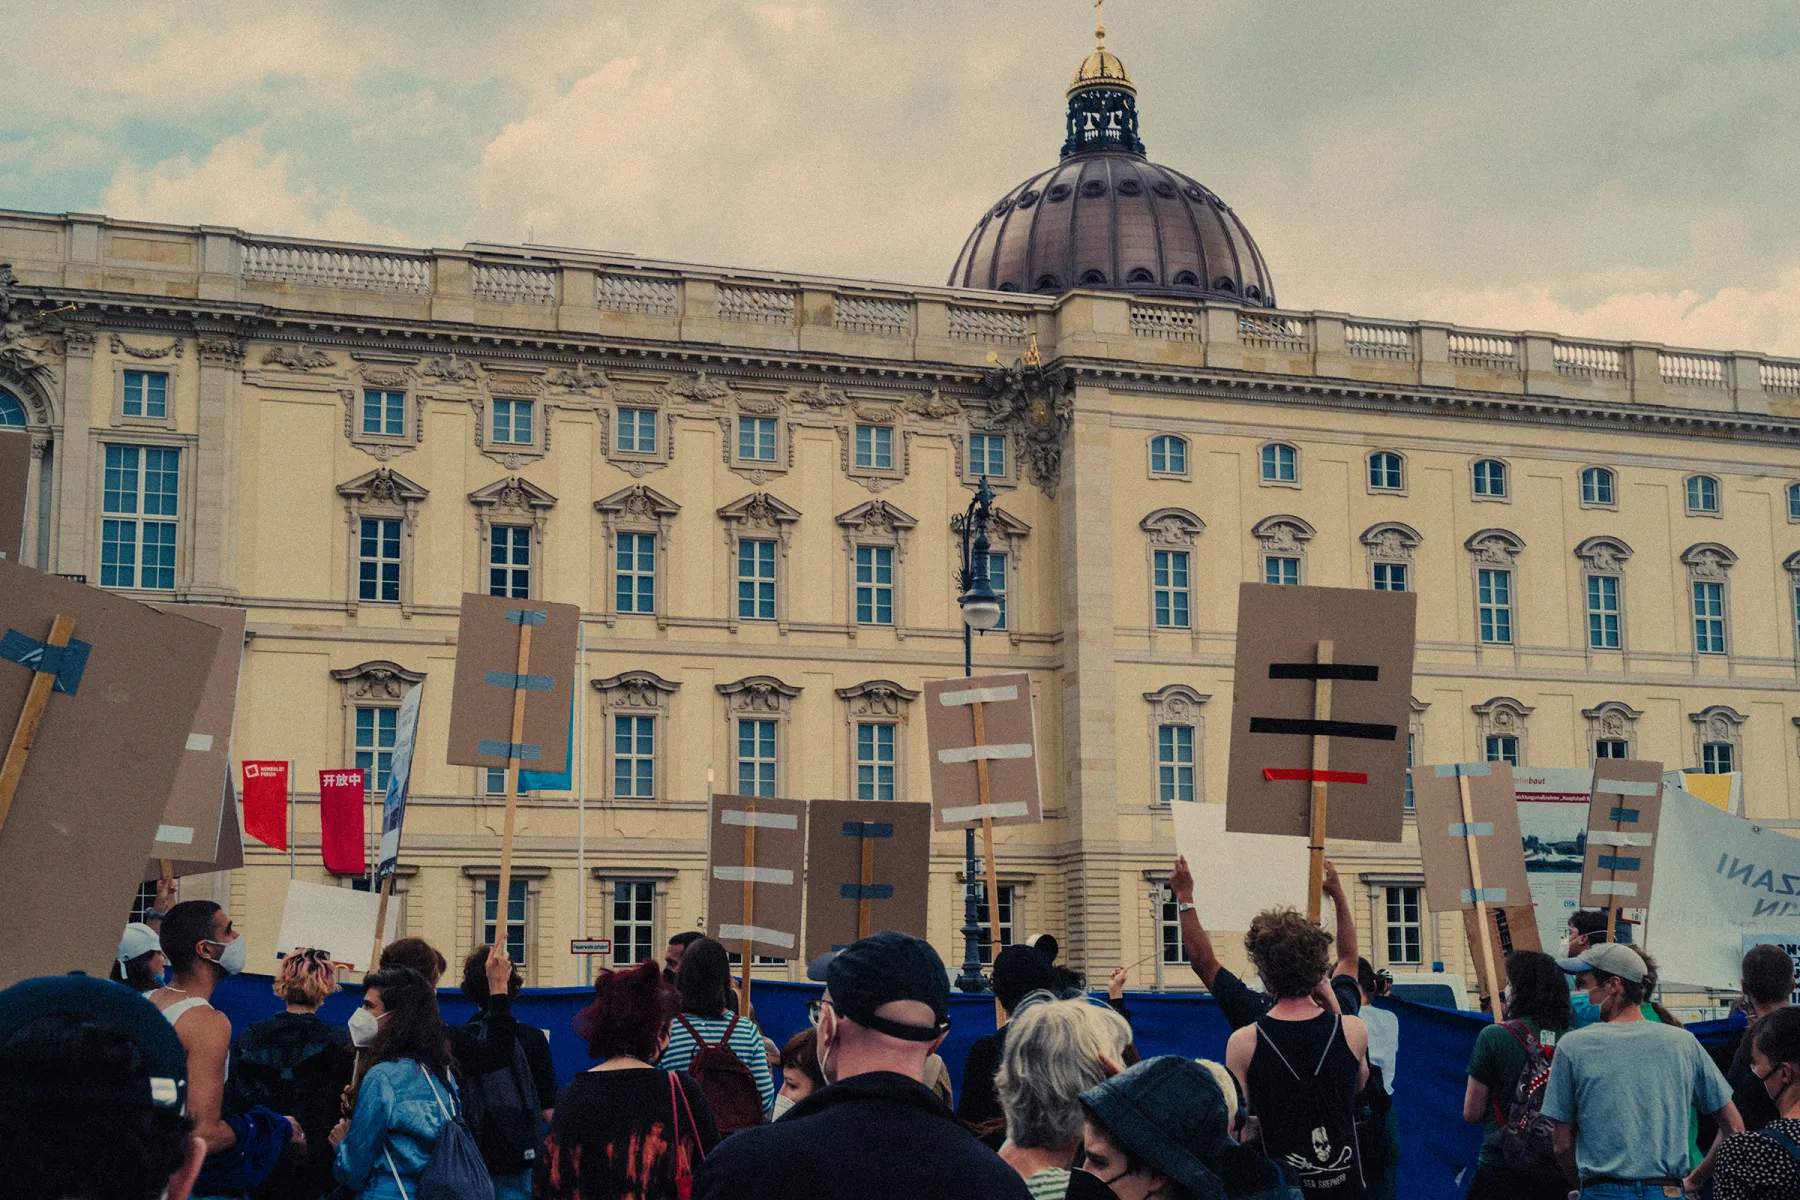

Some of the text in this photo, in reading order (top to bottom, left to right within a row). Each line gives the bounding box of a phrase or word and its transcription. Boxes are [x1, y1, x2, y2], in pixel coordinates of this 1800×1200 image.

[322, 773, 361, 787] 开放中
[1303, 1179, 1317, 1188] SEA
